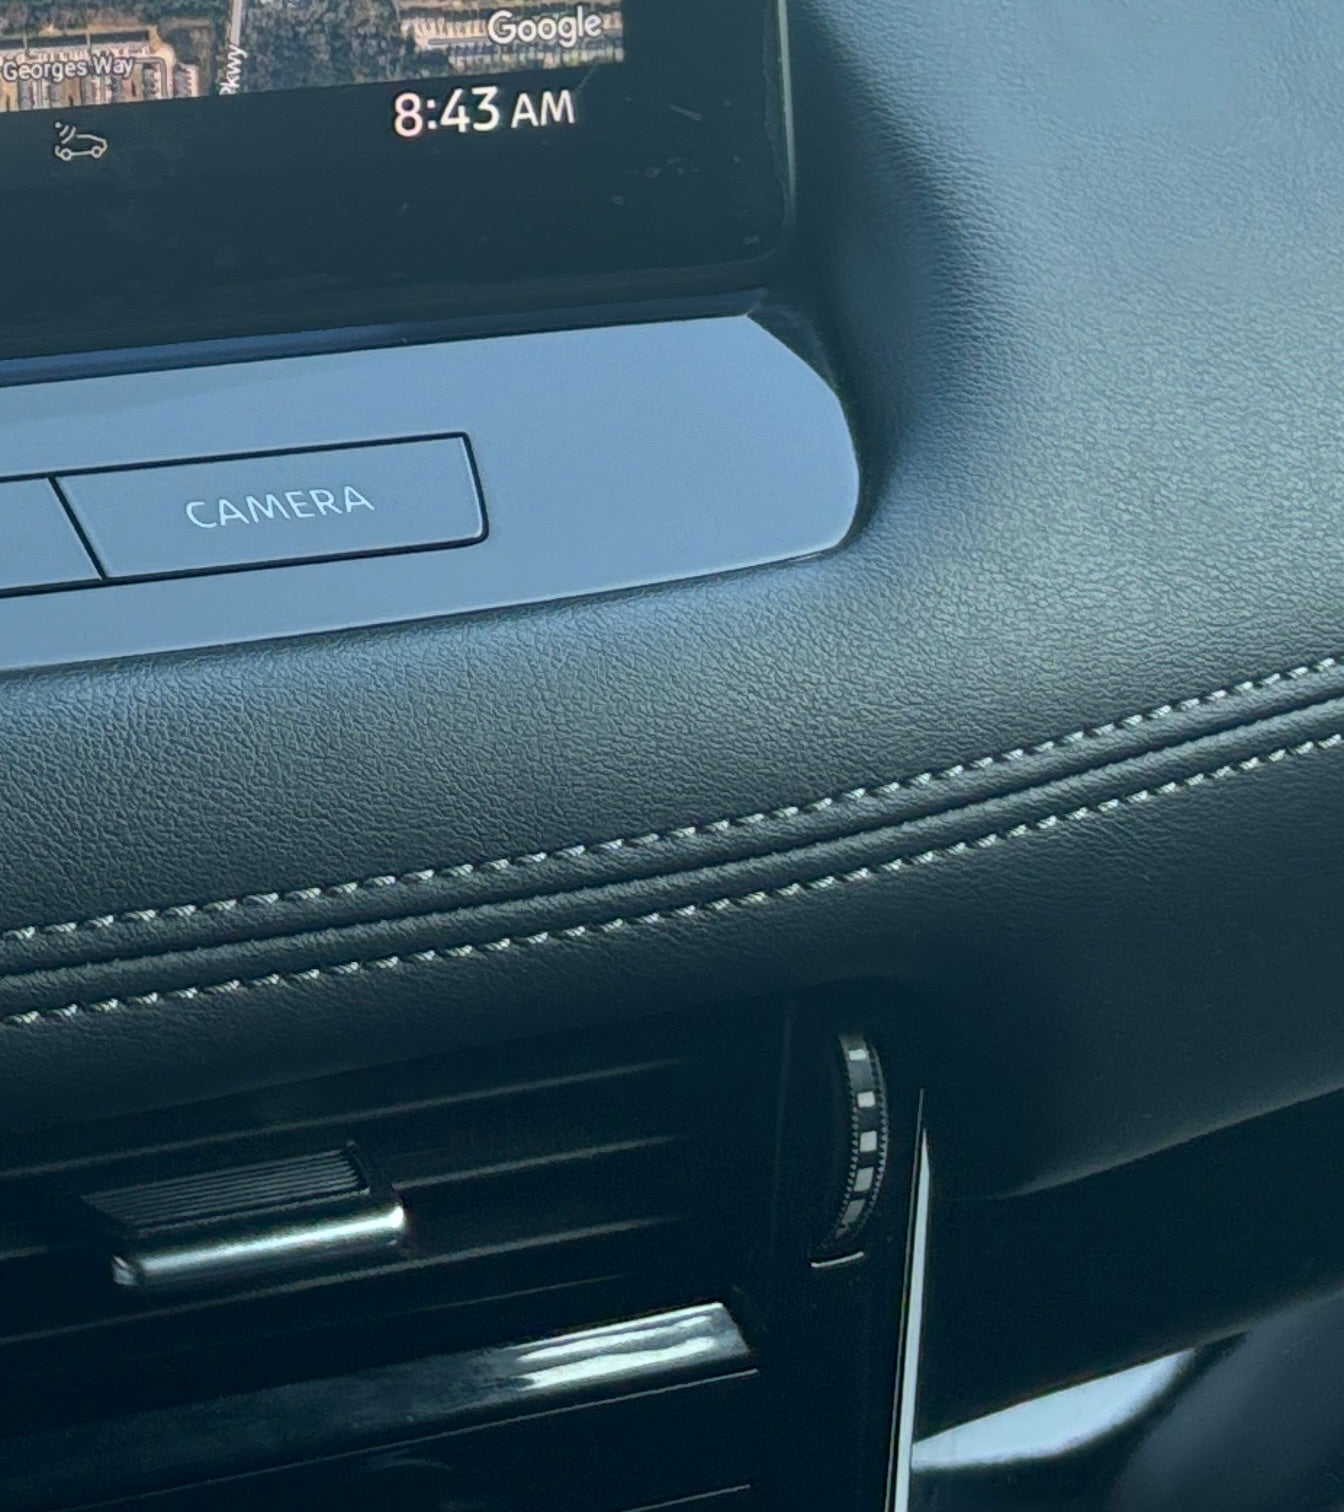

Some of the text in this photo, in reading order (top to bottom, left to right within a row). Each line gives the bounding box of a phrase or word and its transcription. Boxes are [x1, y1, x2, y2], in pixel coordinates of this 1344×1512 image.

[488, 6, 602, 47] Google
[2, 55, 134, 82] Georges Way
[394, 86, 576, 137] 8:43 AM
[185, 485, 375, 530] CAMERA
